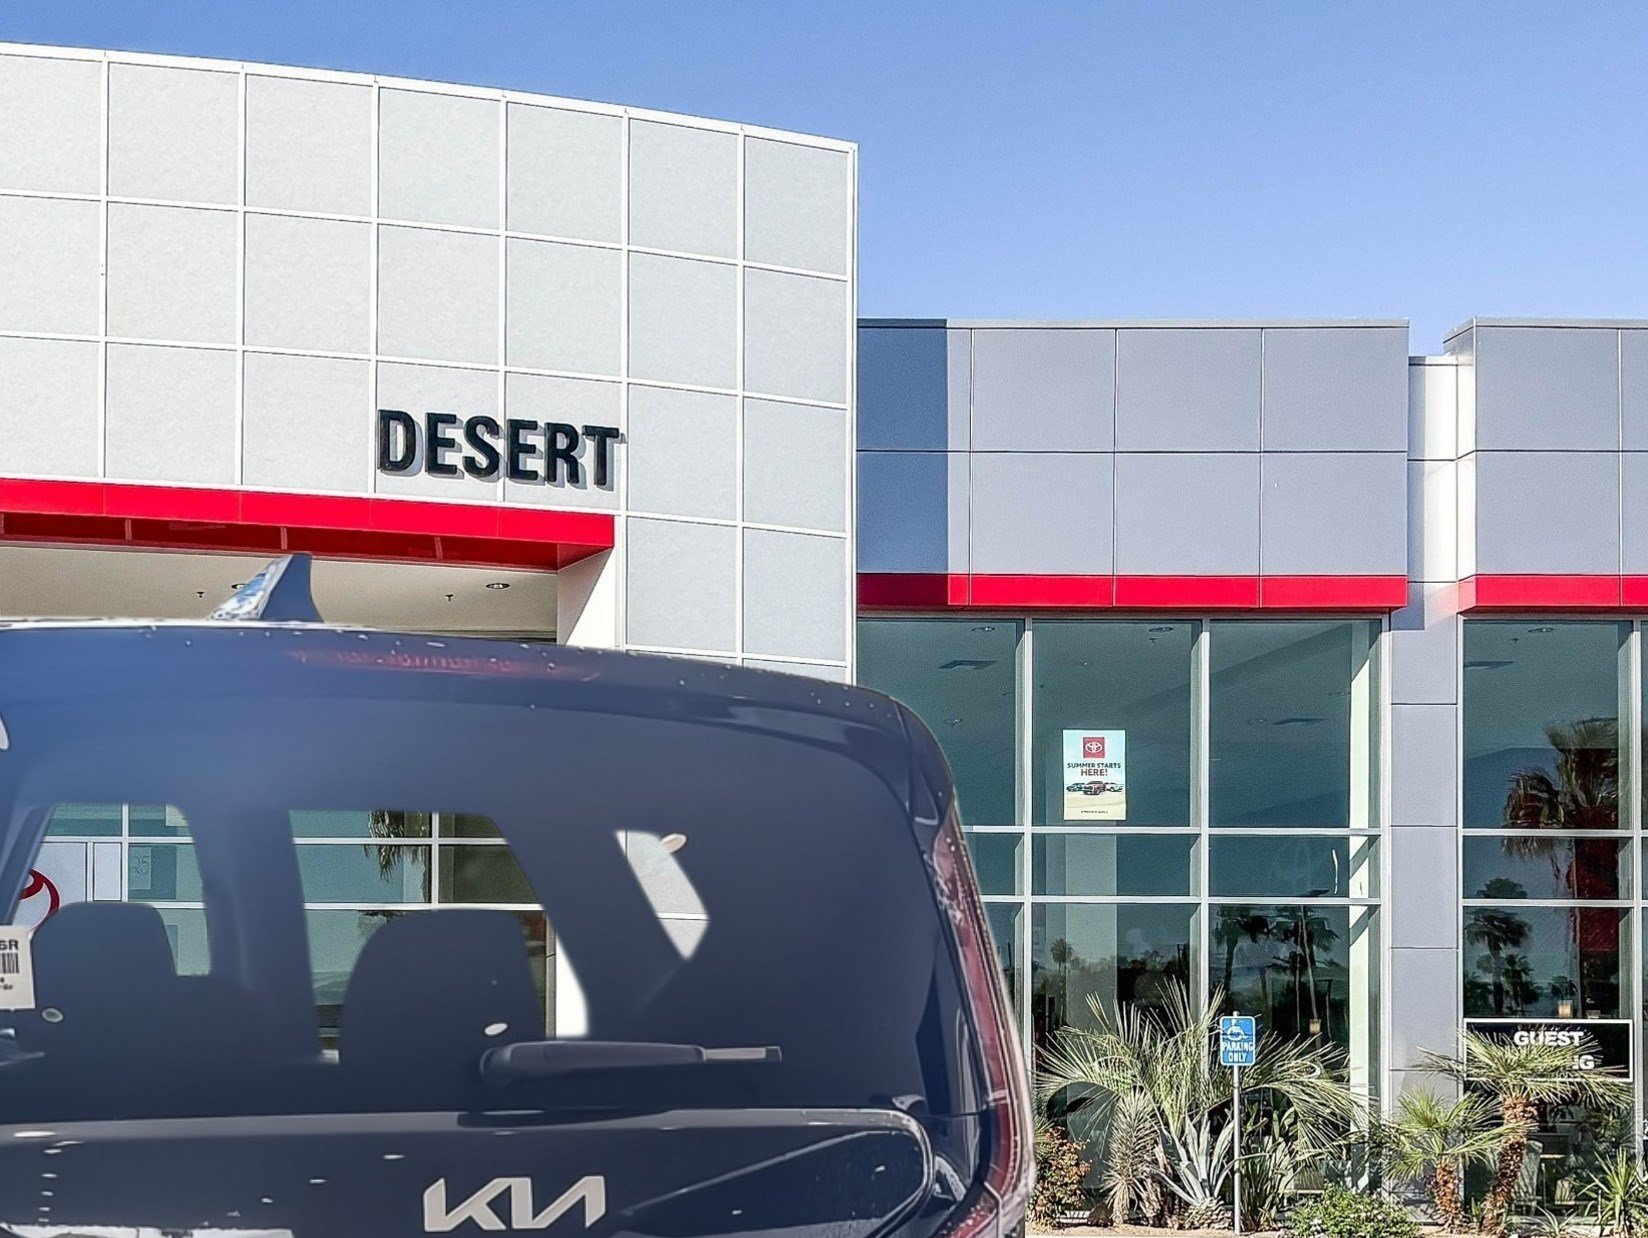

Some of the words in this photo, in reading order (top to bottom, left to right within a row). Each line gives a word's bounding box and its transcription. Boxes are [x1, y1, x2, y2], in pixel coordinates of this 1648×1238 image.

[377, 409, 620, 486] DESERT
[1513, 1031, 1584, 1046] GUEST
[1222, 1041, 1253, 1052] PARKING
[1228, 1052, 1247, 1063] ONLY
[423, 1176, 606, 1232] KIA
